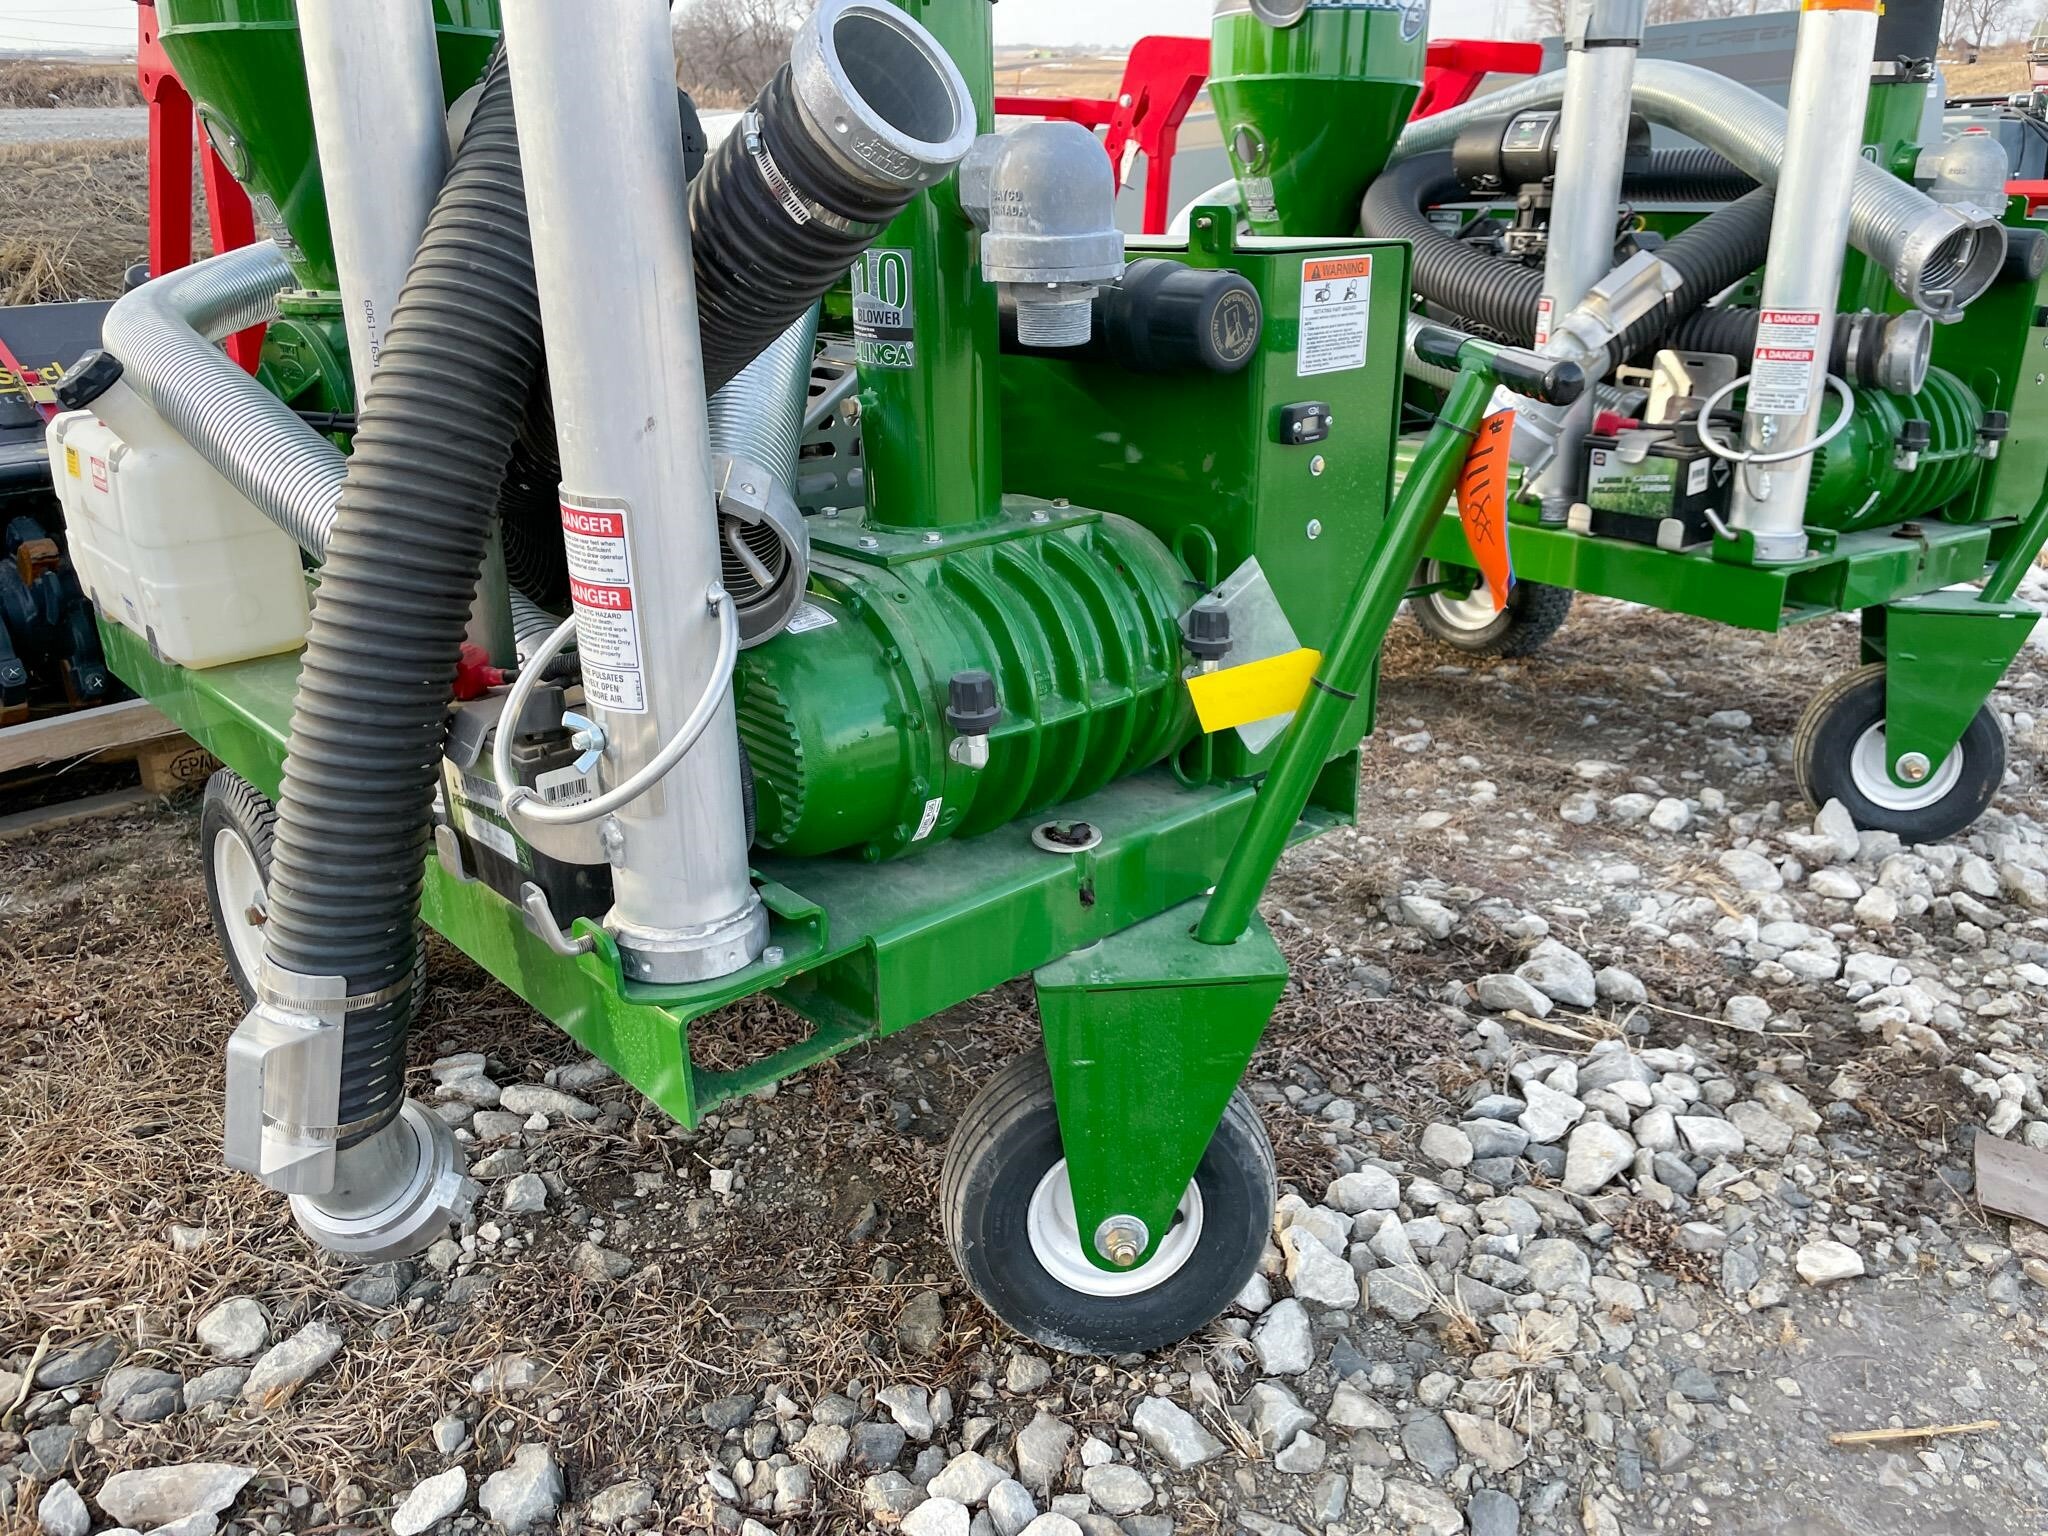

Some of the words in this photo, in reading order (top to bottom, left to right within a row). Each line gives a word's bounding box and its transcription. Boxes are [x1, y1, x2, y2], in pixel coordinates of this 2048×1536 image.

[1322, 262, 1364, 276] WARNING
[858, 309, 900, 325] BLOWER
[1773, 314, 1815, 324] DANGER
[857, 340, 912, 366] LINGA
[1768, 351, 1809, 360] DANGER
[595, 611, 622, 619] HAZARD
[592, 670, 624, 683] PULSATES
[601, 682, 619, 693] OPEN
[592, 690, 608, 701] MORE
